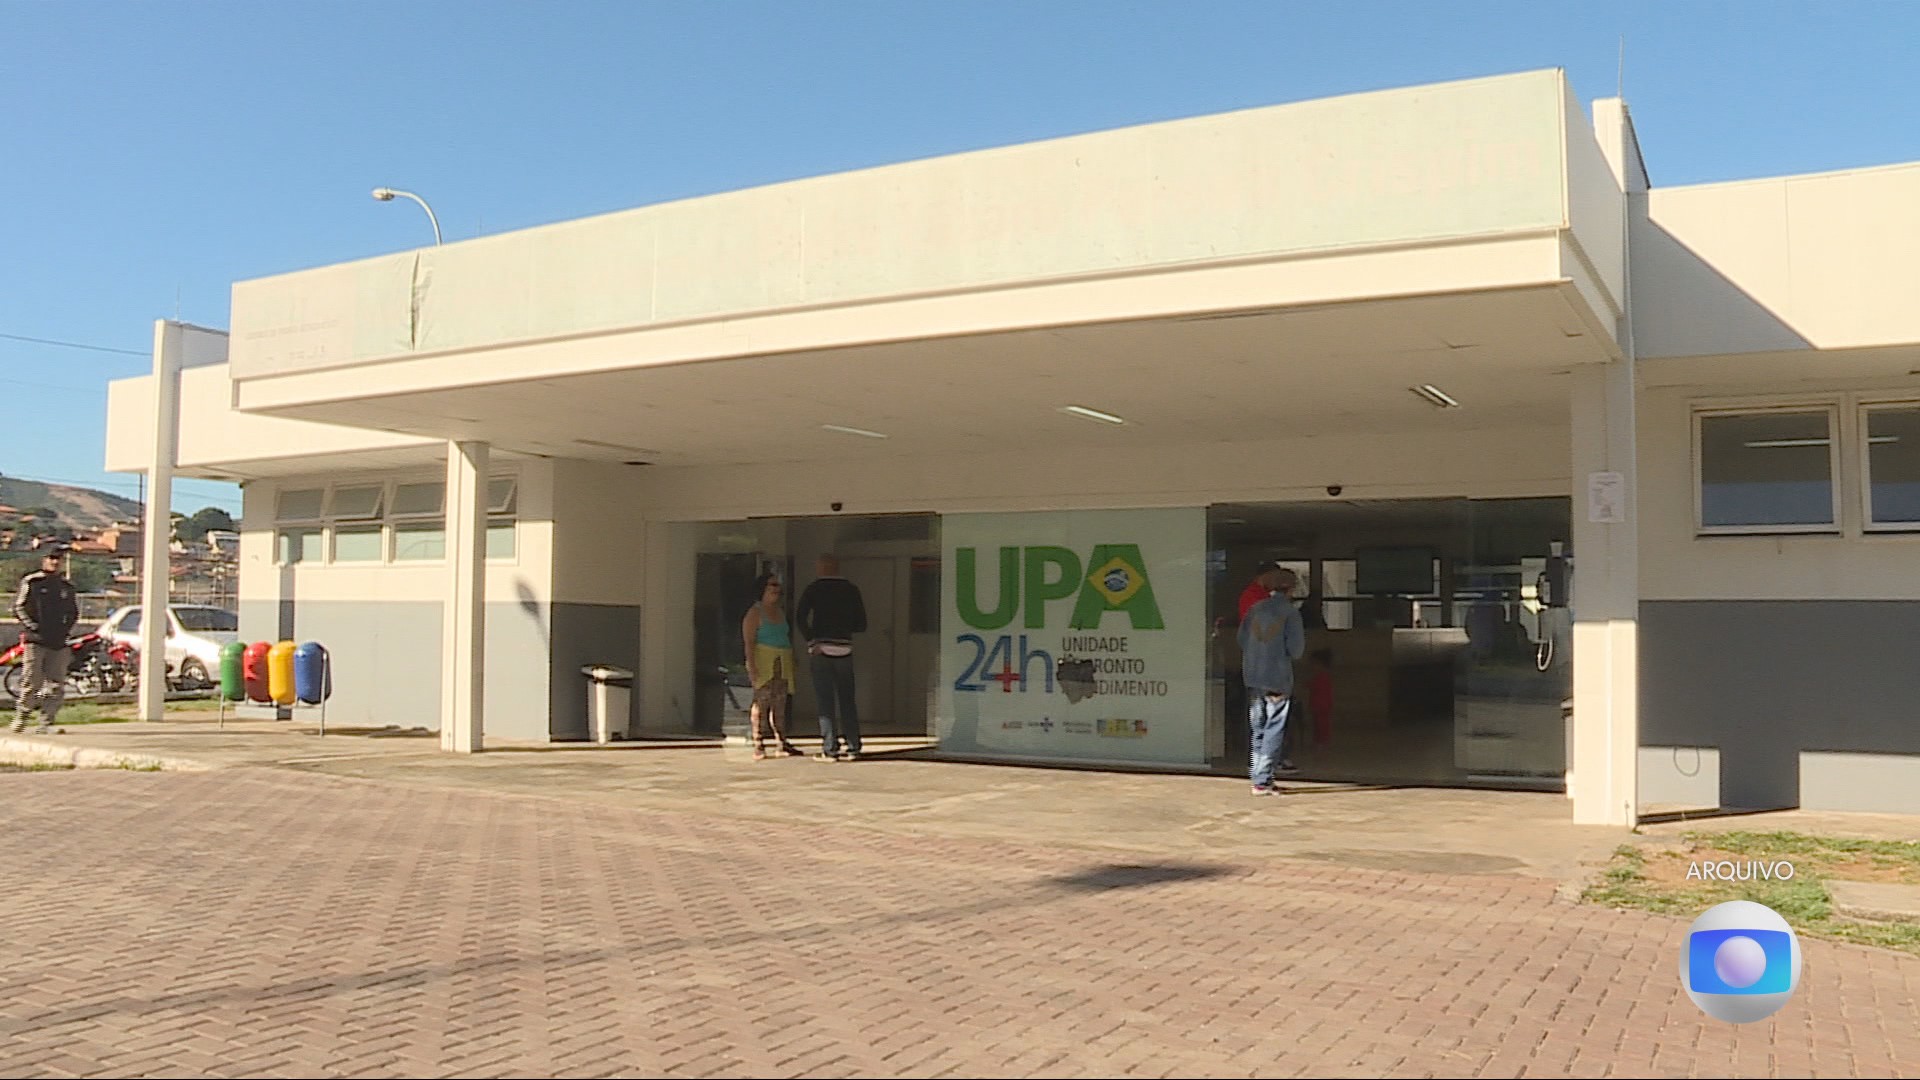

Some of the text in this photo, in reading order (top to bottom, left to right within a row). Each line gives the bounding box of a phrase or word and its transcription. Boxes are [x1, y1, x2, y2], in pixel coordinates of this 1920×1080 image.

[955, 543, 1165, 631] UPA
[954, 633, 1054, 693] 24h
[1062, 636, 1128, 652] UNIDADE
[1092, 658, 1145, 674] RONTO
